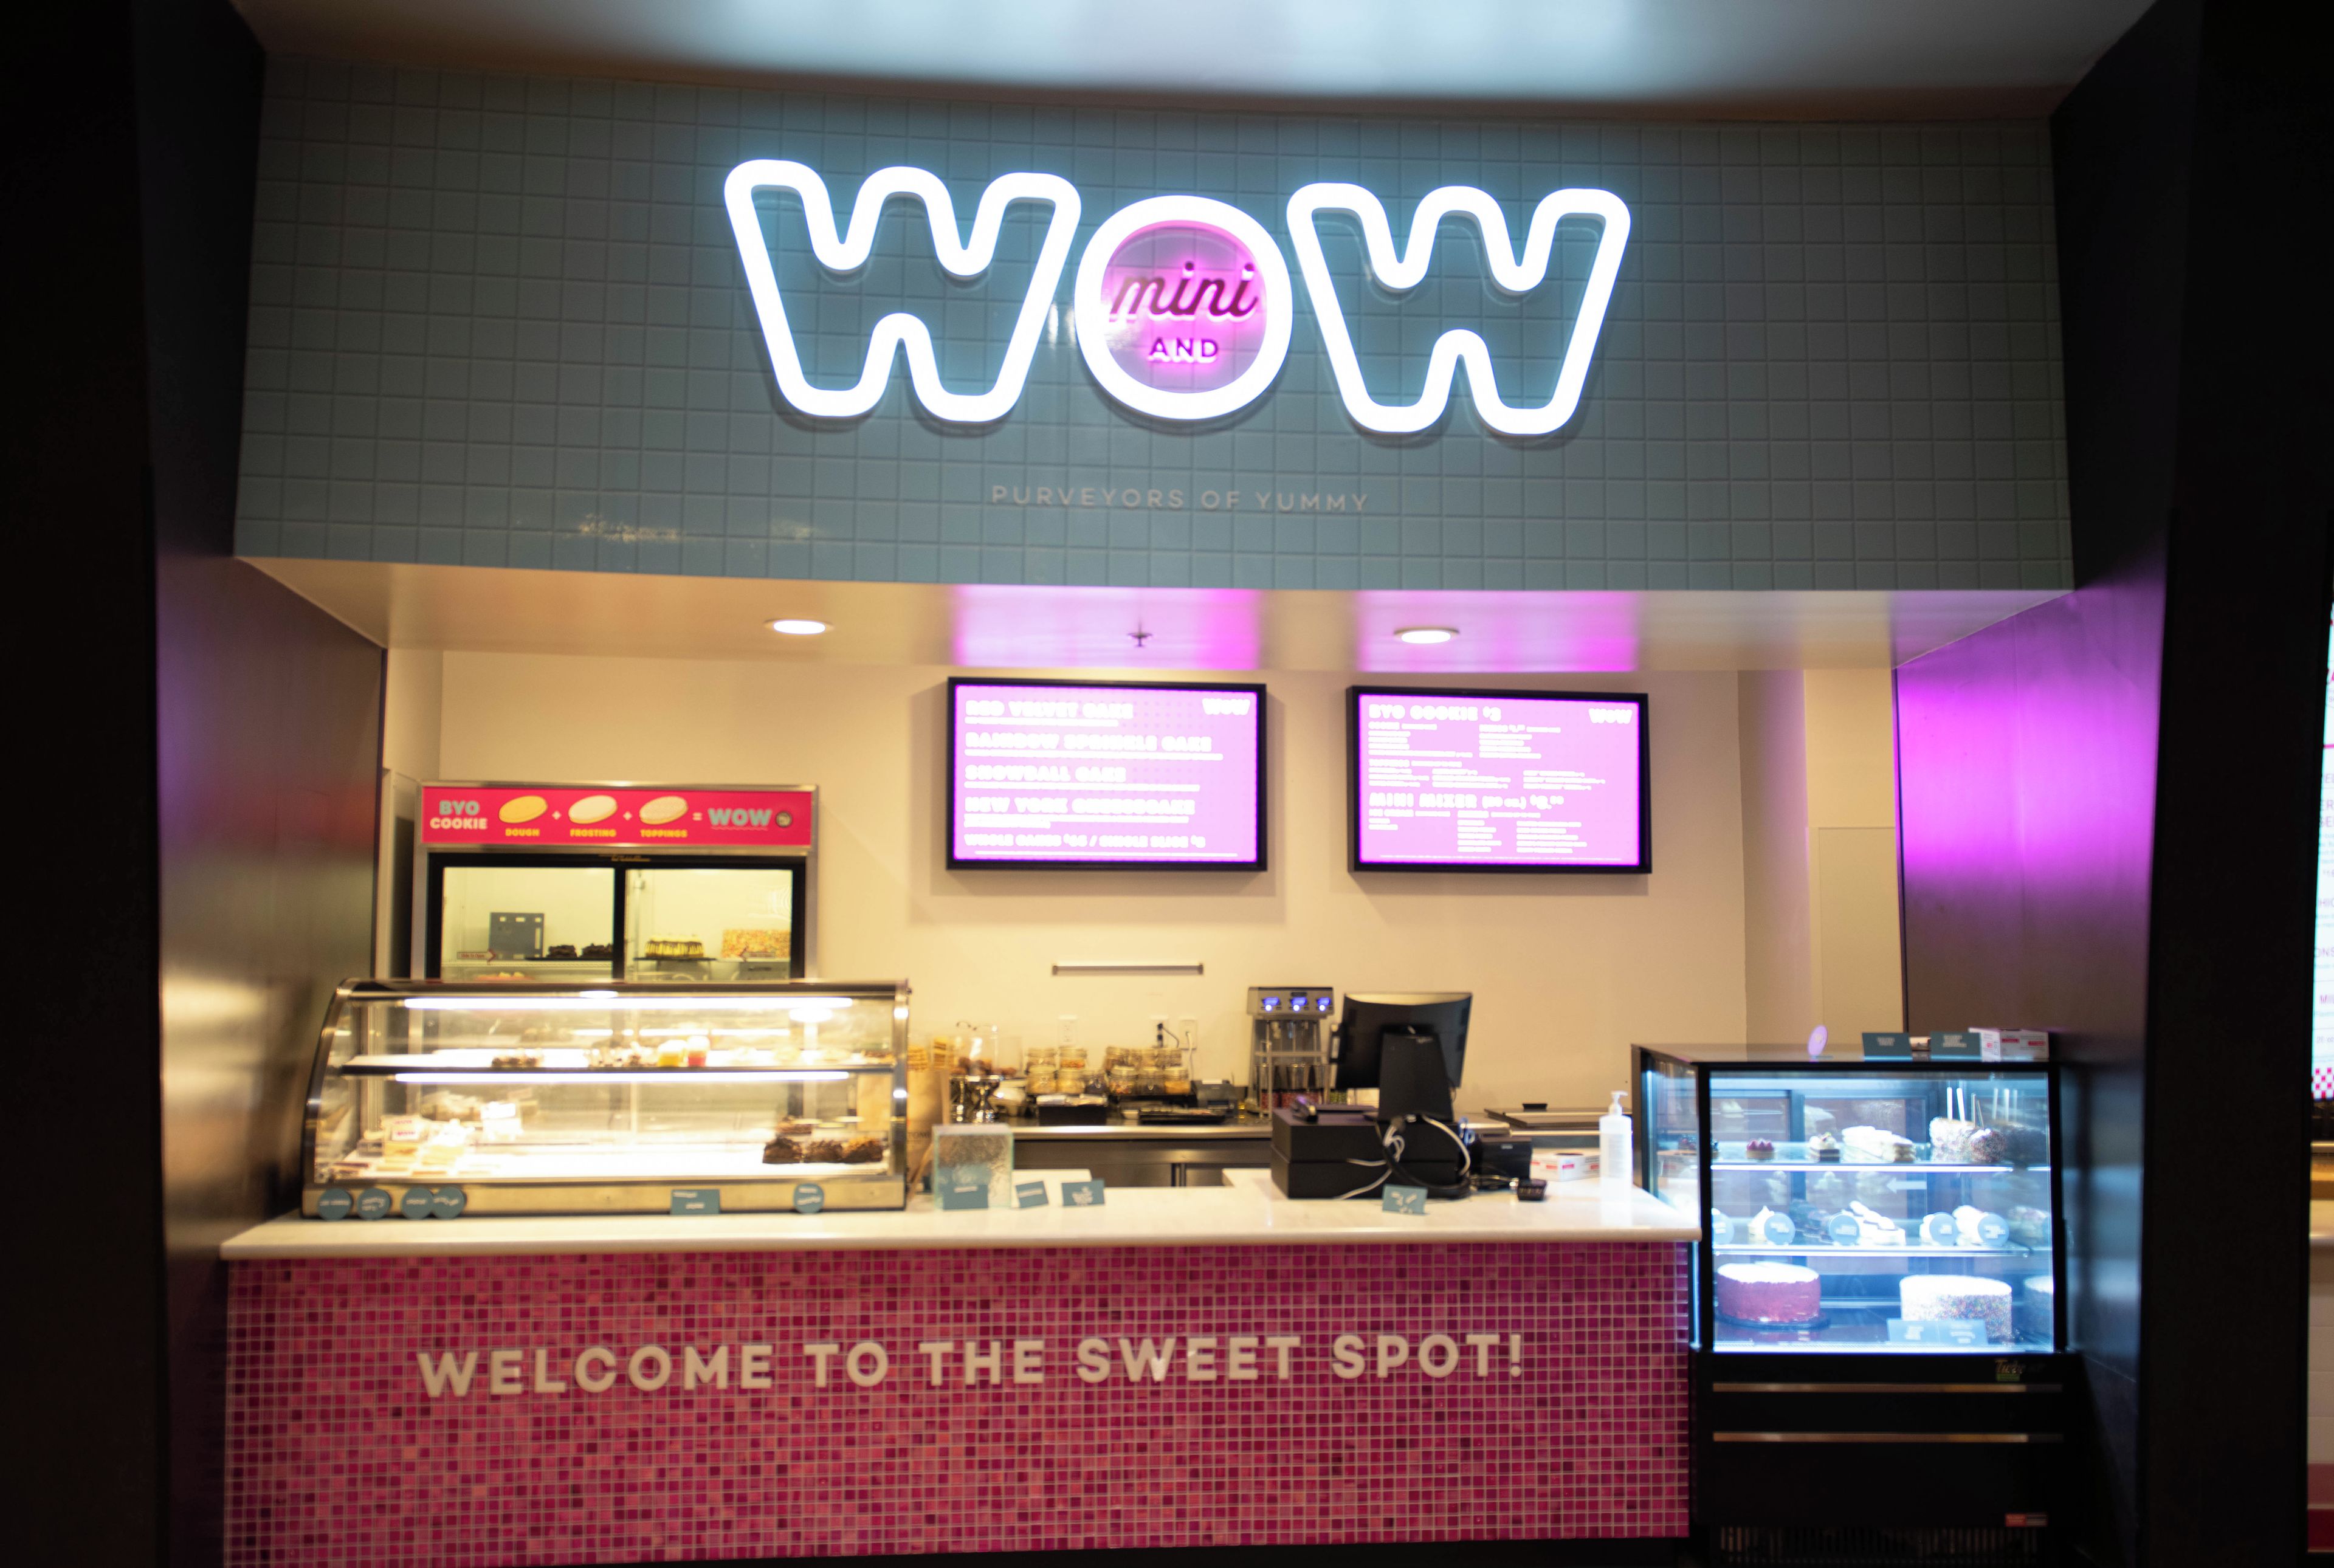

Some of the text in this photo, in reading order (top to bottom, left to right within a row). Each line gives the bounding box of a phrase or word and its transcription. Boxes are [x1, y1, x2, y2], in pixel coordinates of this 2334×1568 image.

[724, 159, 1631, 434] WOW
[1109, 260, 1259, 317] mini
[1149, 337, 1219, 360] AND
[991, 485, 1369, 512] PURVEYORS OF YUMMY
[439, 800, 480, 815] BYO
[707, 808, 772, 826] WOW
[429, 817, 487, 830] COOKIE
[640, 829, 687, 837] TOPPINGS
[416, 1333, 1523, 1397] WELCOME TO THE SWEET SPOT!
